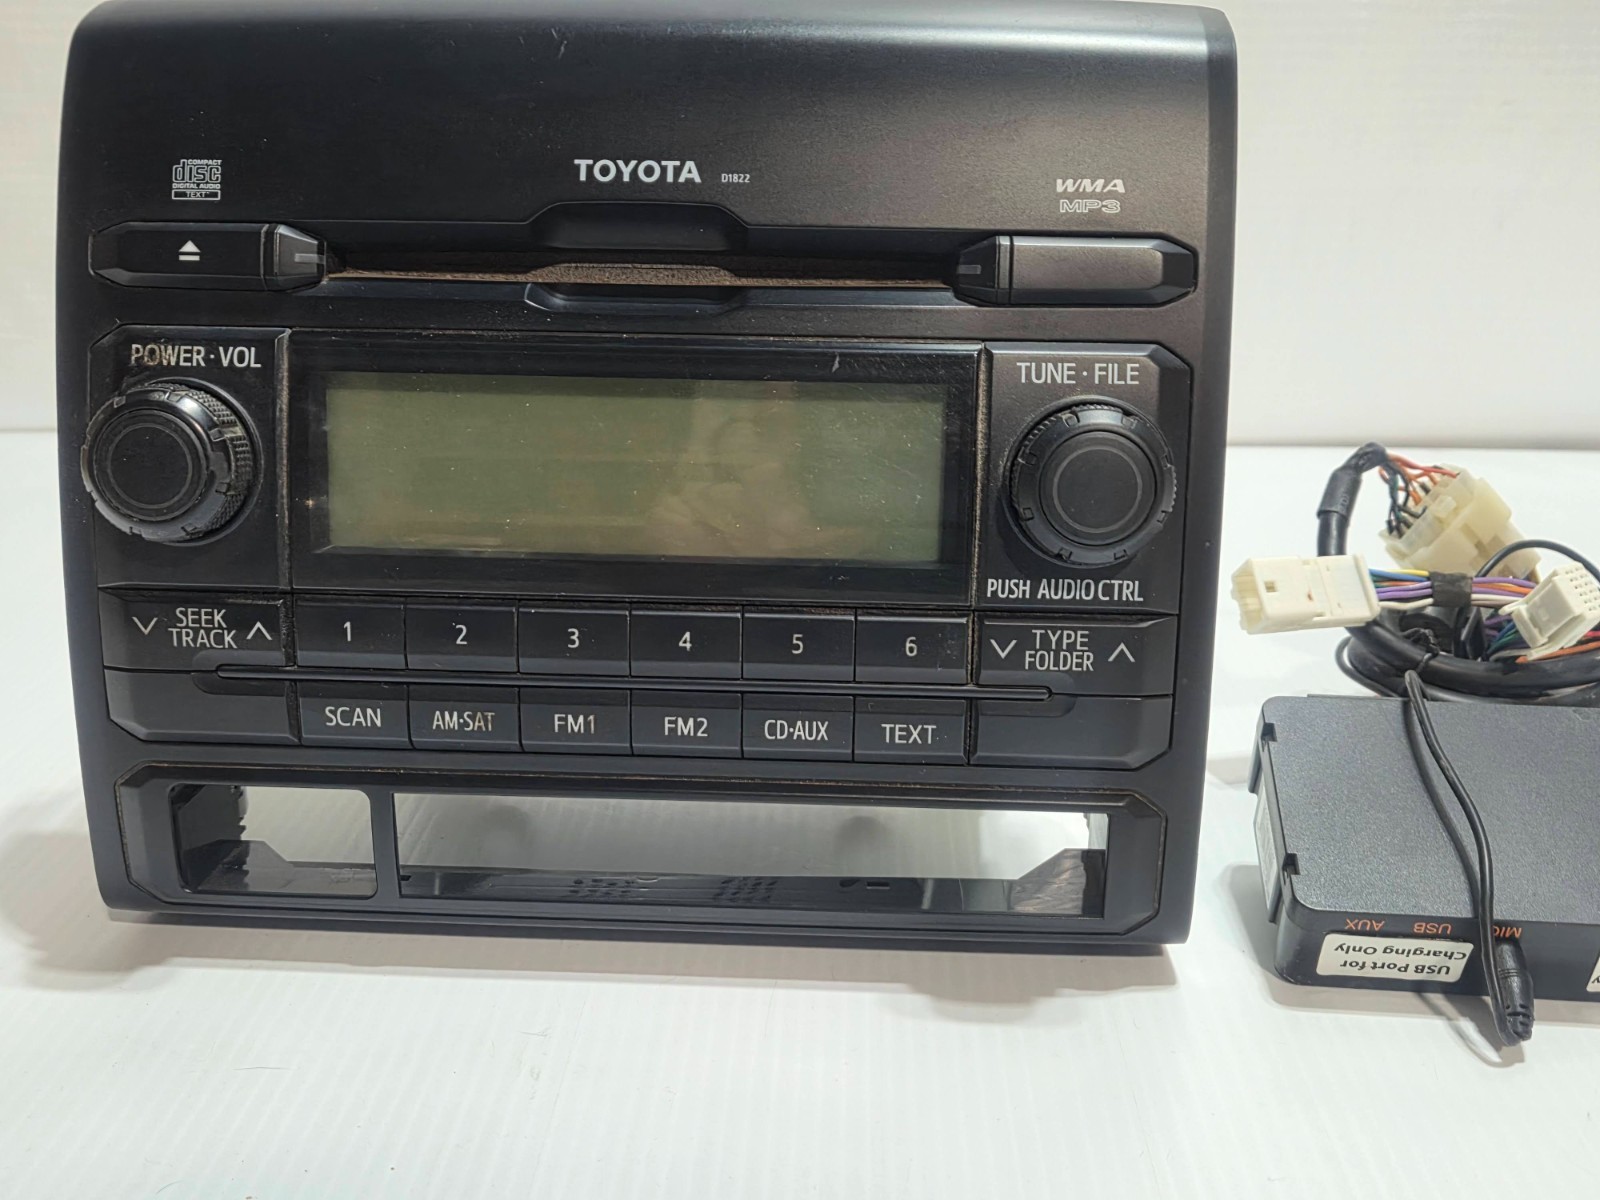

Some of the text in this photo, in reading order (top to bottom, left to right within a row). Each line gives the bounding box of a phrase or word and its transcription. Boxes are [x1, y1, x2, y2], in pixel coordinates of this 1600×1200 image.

[573, 158, 702, 183] TOYOTA
[721, 173, 751, 183] D1822
[1056, 178, 1126, 193] WMA
[1059, 199, 1121, 214] MP3
[1016, 362, 1140, 384] TUNE FILE
[987, 578, 1144, 601] PUSH AUDIO CTRL
[175, 607, 228, 628] SEEK
[168, 628, 238, 649] TRACK
[343, 621, 352, 642] 1
[455, 624, 468, 645] 2
[567, 628, 580, 648] 3
[678, 631, 692, 651] 4
[1031, 629, 1090, 650] TYPE
[791, 634, 804, 654] 5
[905, 637, 918, 657] 6
[1025, 650, 1094, 671] FOLDER
[324, 706, 382, 728] SCAN
[553, 713, 596, 735] FM1
[663, 716, 708, 738] FM2
[881, 723, 937, 744] TEXT
[1344, 918, 1386, 932] AUX
[1413, 921, 1452, 935] USB
[1333, 942, 1467, 961] Charging Only
[1340, 959, 1451, 976] USB Port for
